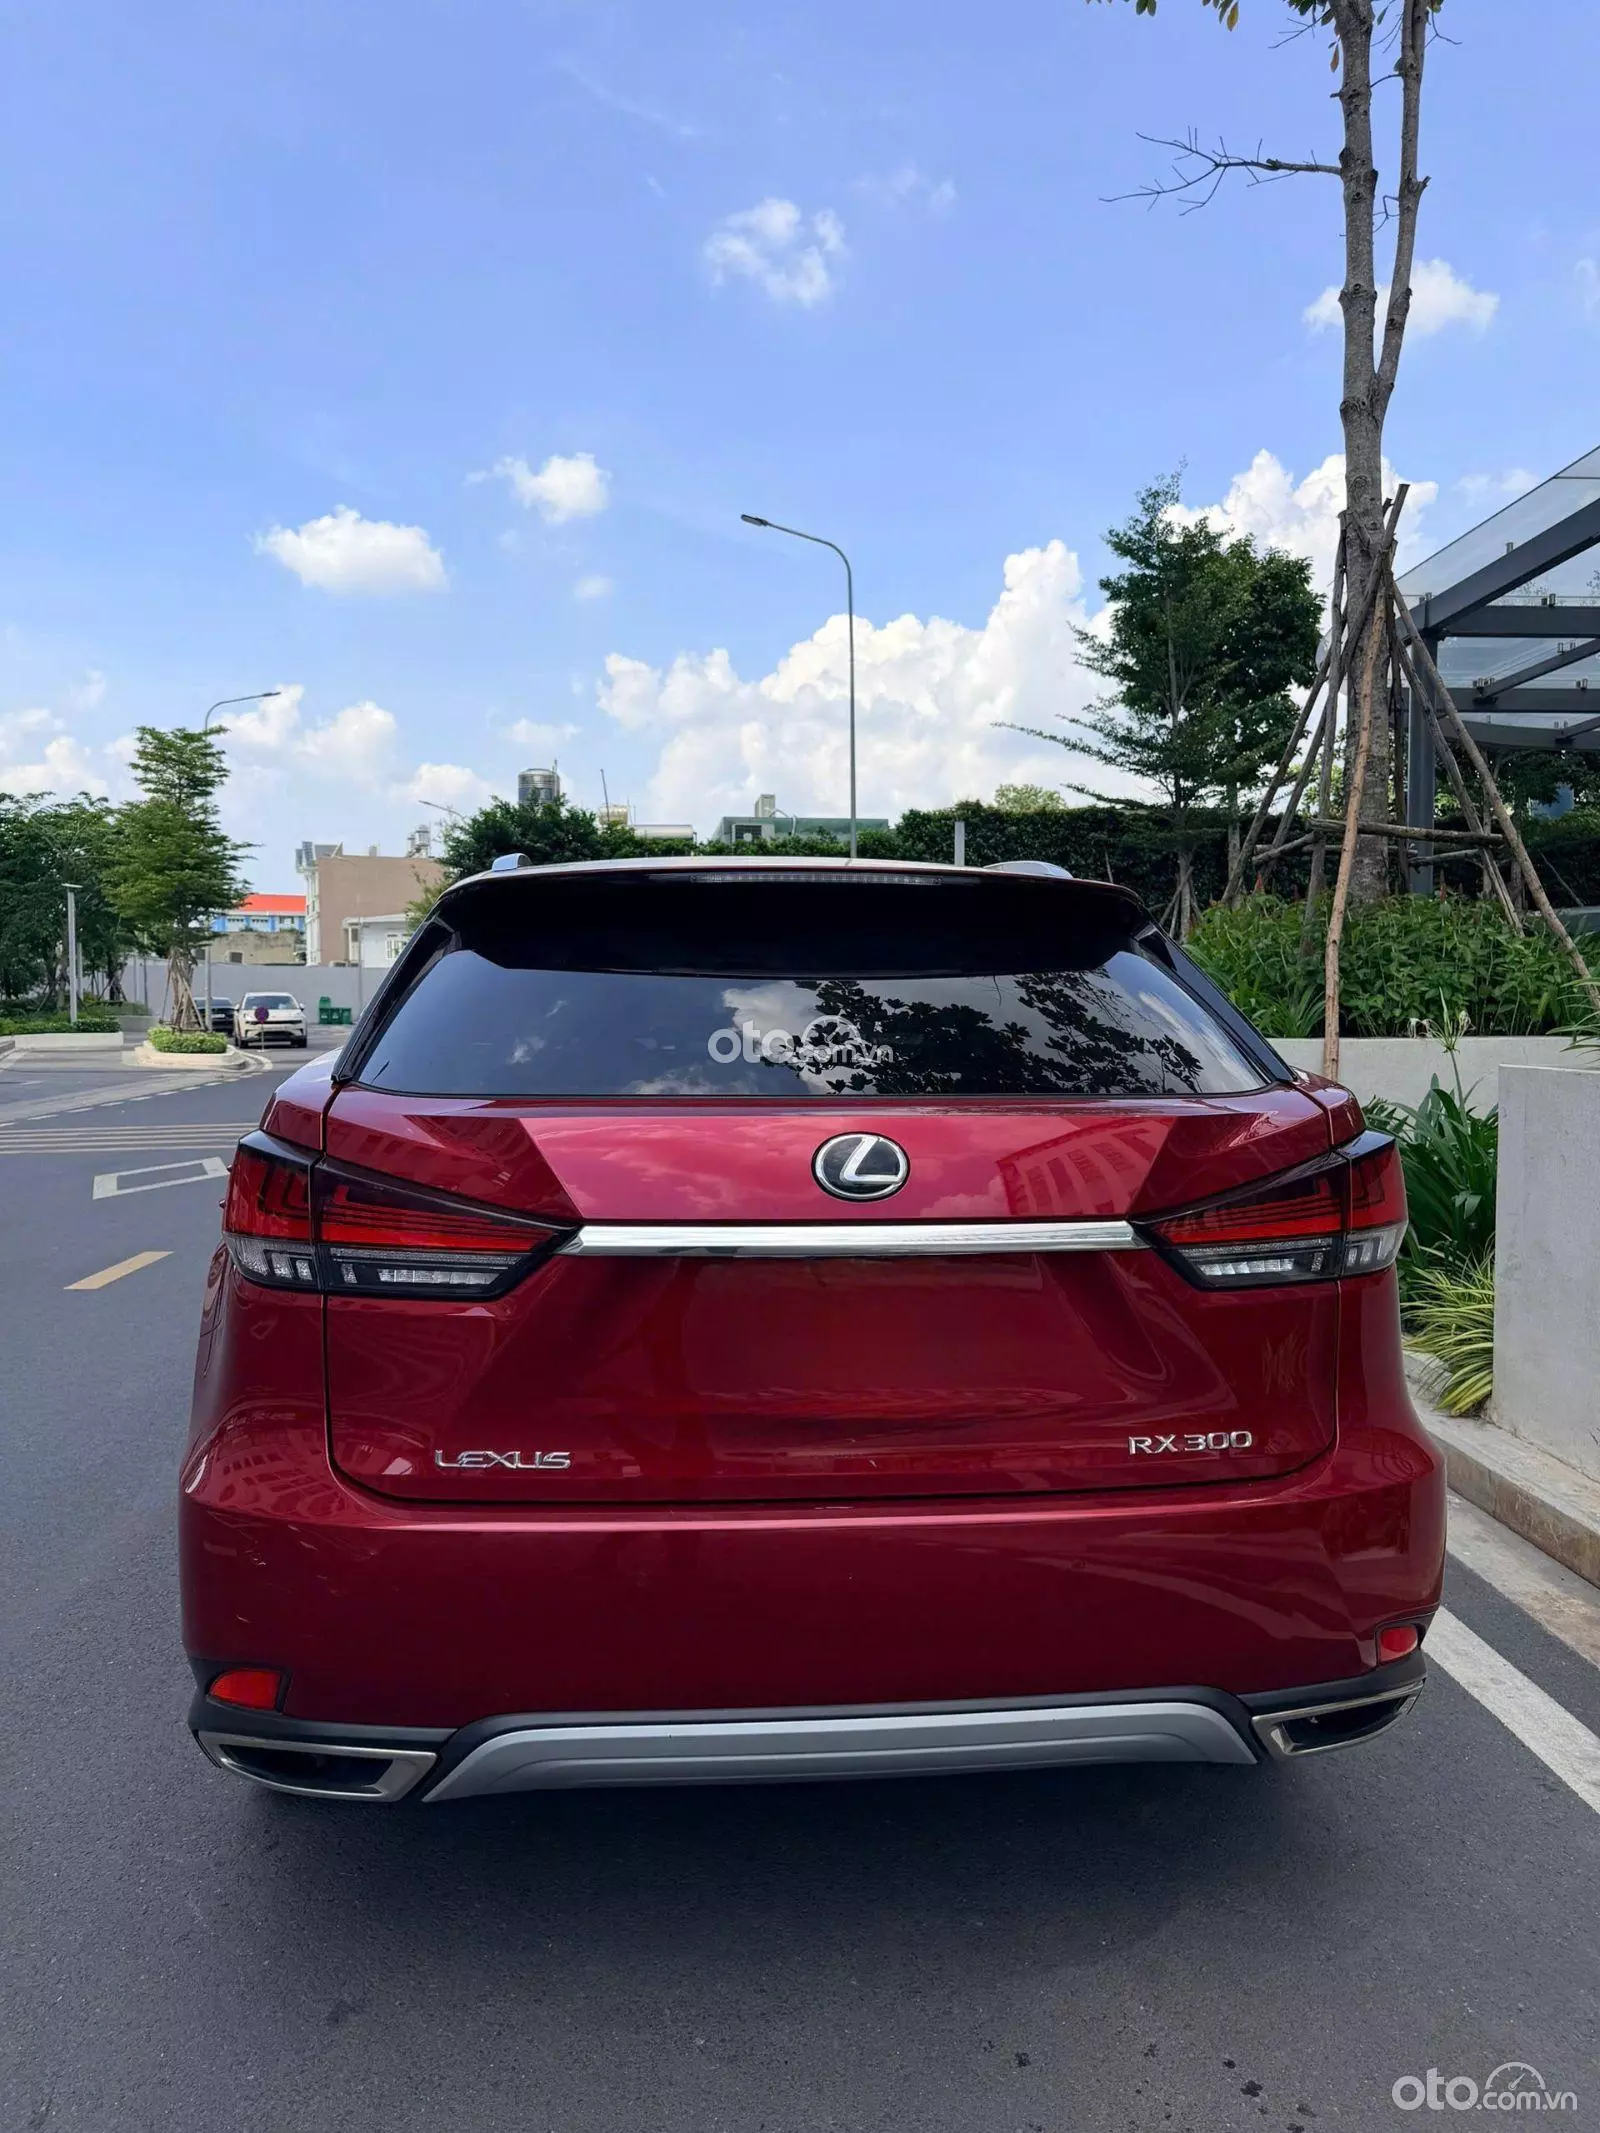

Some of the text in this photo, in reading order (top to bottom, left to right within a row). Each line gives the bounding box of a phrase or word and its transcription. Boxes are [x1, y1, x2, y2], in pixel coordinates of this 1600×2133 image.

[1128, 1430, 1252, 1455] RX 300
[434, 1449, 571, 1469] LEXUS
